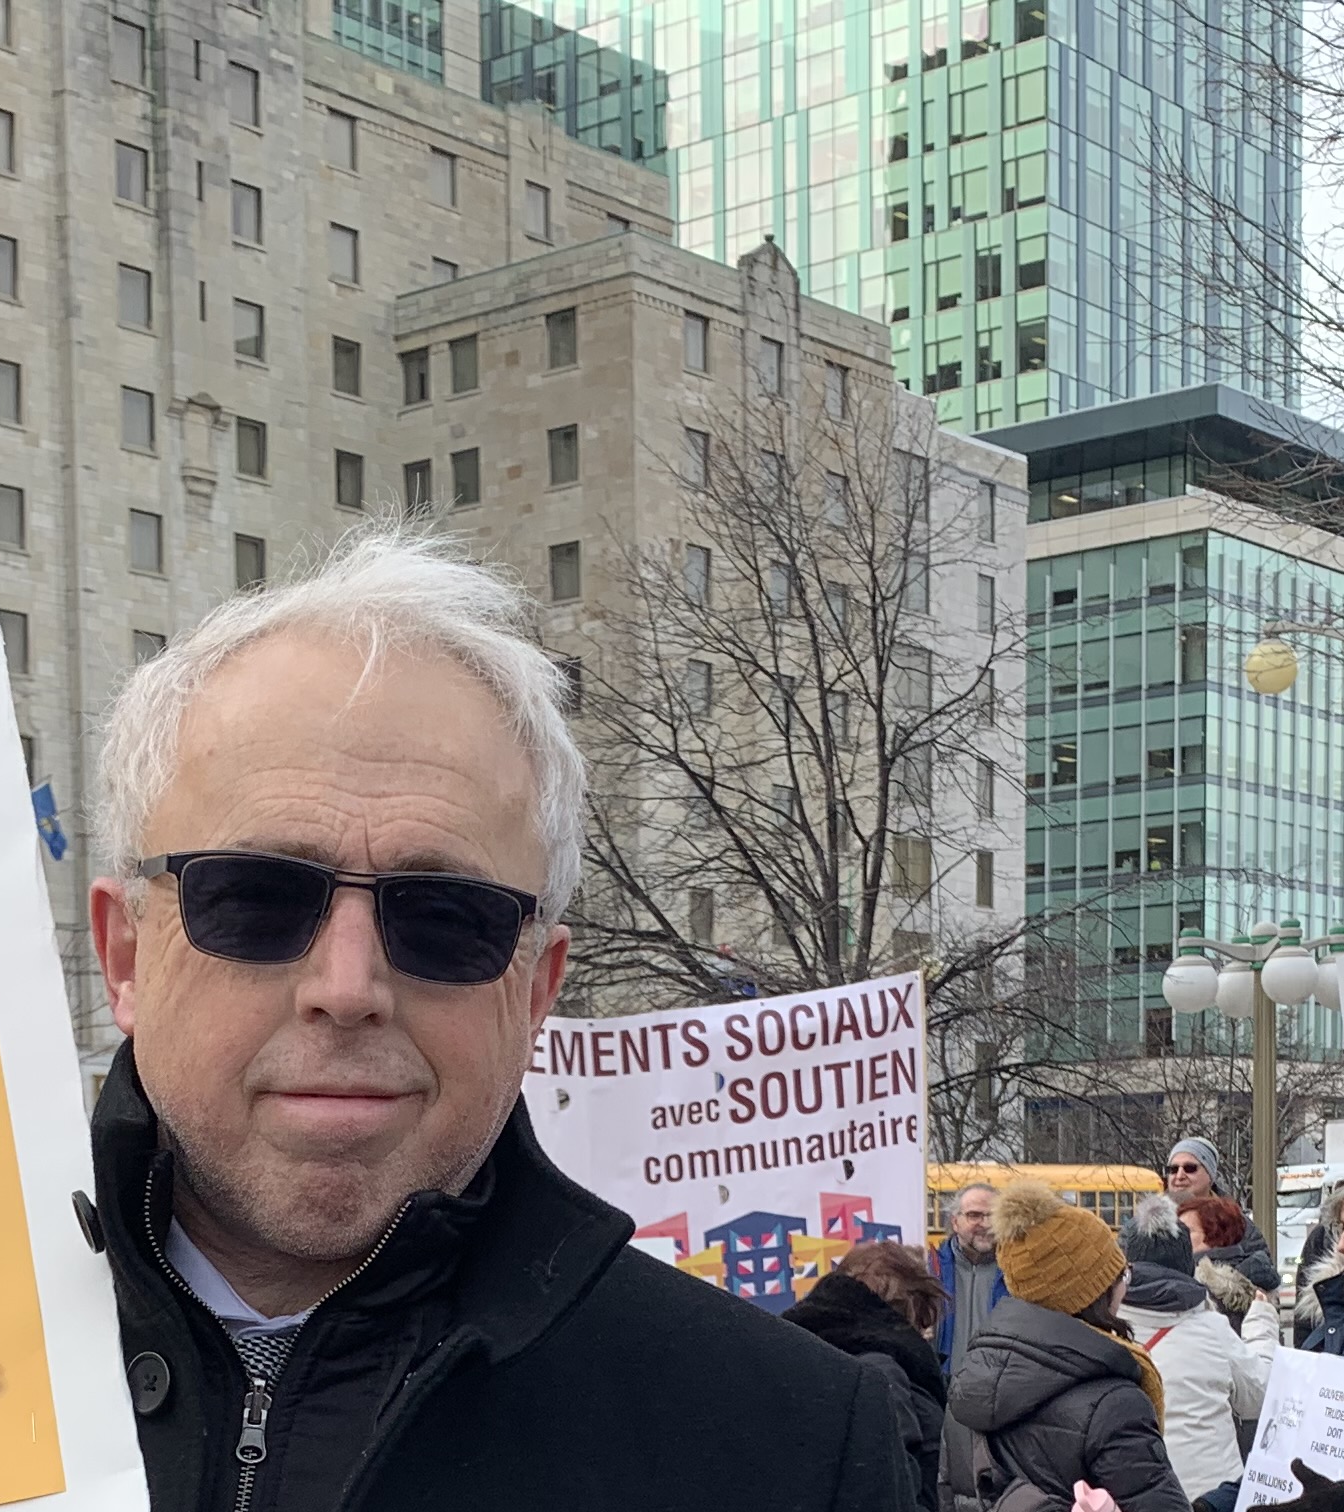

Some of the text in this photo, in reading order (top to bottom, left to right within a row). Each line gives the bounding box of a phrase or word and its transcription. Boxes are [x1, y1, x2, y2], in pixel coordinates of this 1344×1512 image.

[724, 982, 915, 1062] SOCIAUX
[650, 1047, 917, 1130] avec SOUTIEN
[644, 1111, 918, 1185] communautaire
[1310, 1441, 1329, 1455] FAIRE
[1326, 1426, 1344, 1439] DOIT
[1247, 1470, 1256, 1482] 50
[1256, 1473, 1287, 1492] MILLIONS
